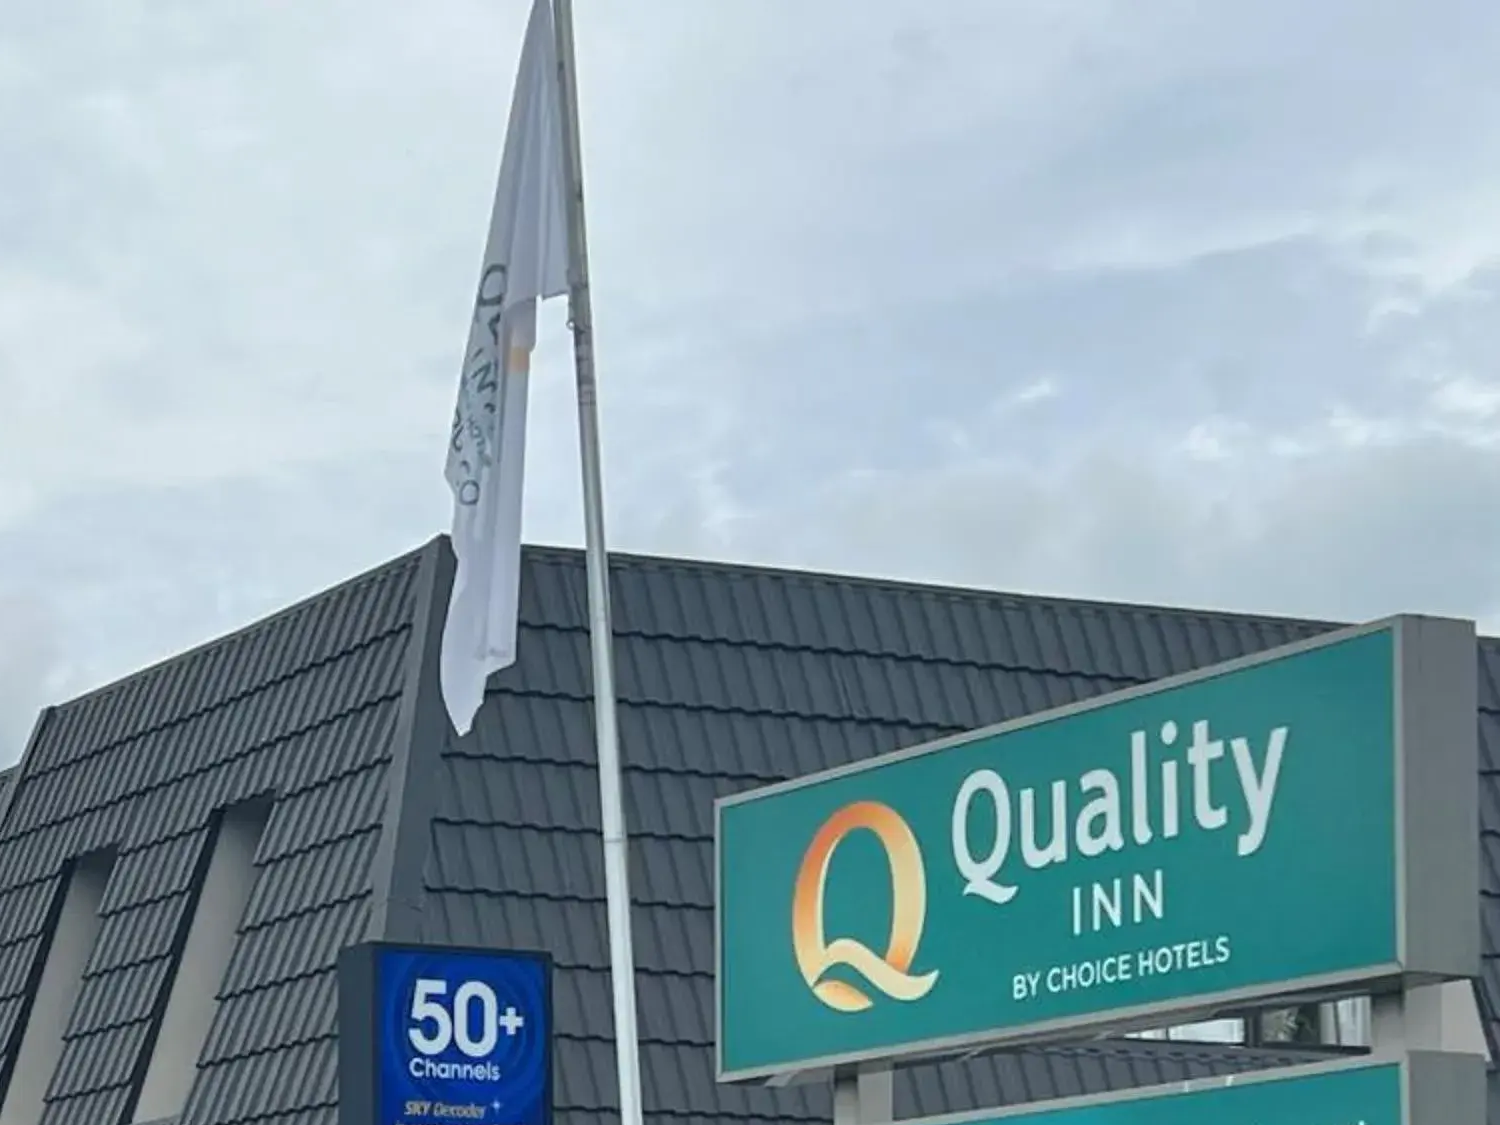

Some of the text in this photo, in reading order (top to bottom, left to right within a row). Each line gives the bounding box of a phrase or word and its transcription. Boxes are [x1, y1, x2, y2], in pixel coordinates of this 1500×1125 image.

[951, 718, 1288, 904] Quality
[792, 800, 939, 1012] Q
[1071, 869, 1165, 936] INN
[1012, 936, 1231, 1001] BY CHOICE HOTELS
[408, 978, 524, 1057] 50+
[409, 1057, 501, 1082] Channels
[404, 1100, 431, 1116] SKY
